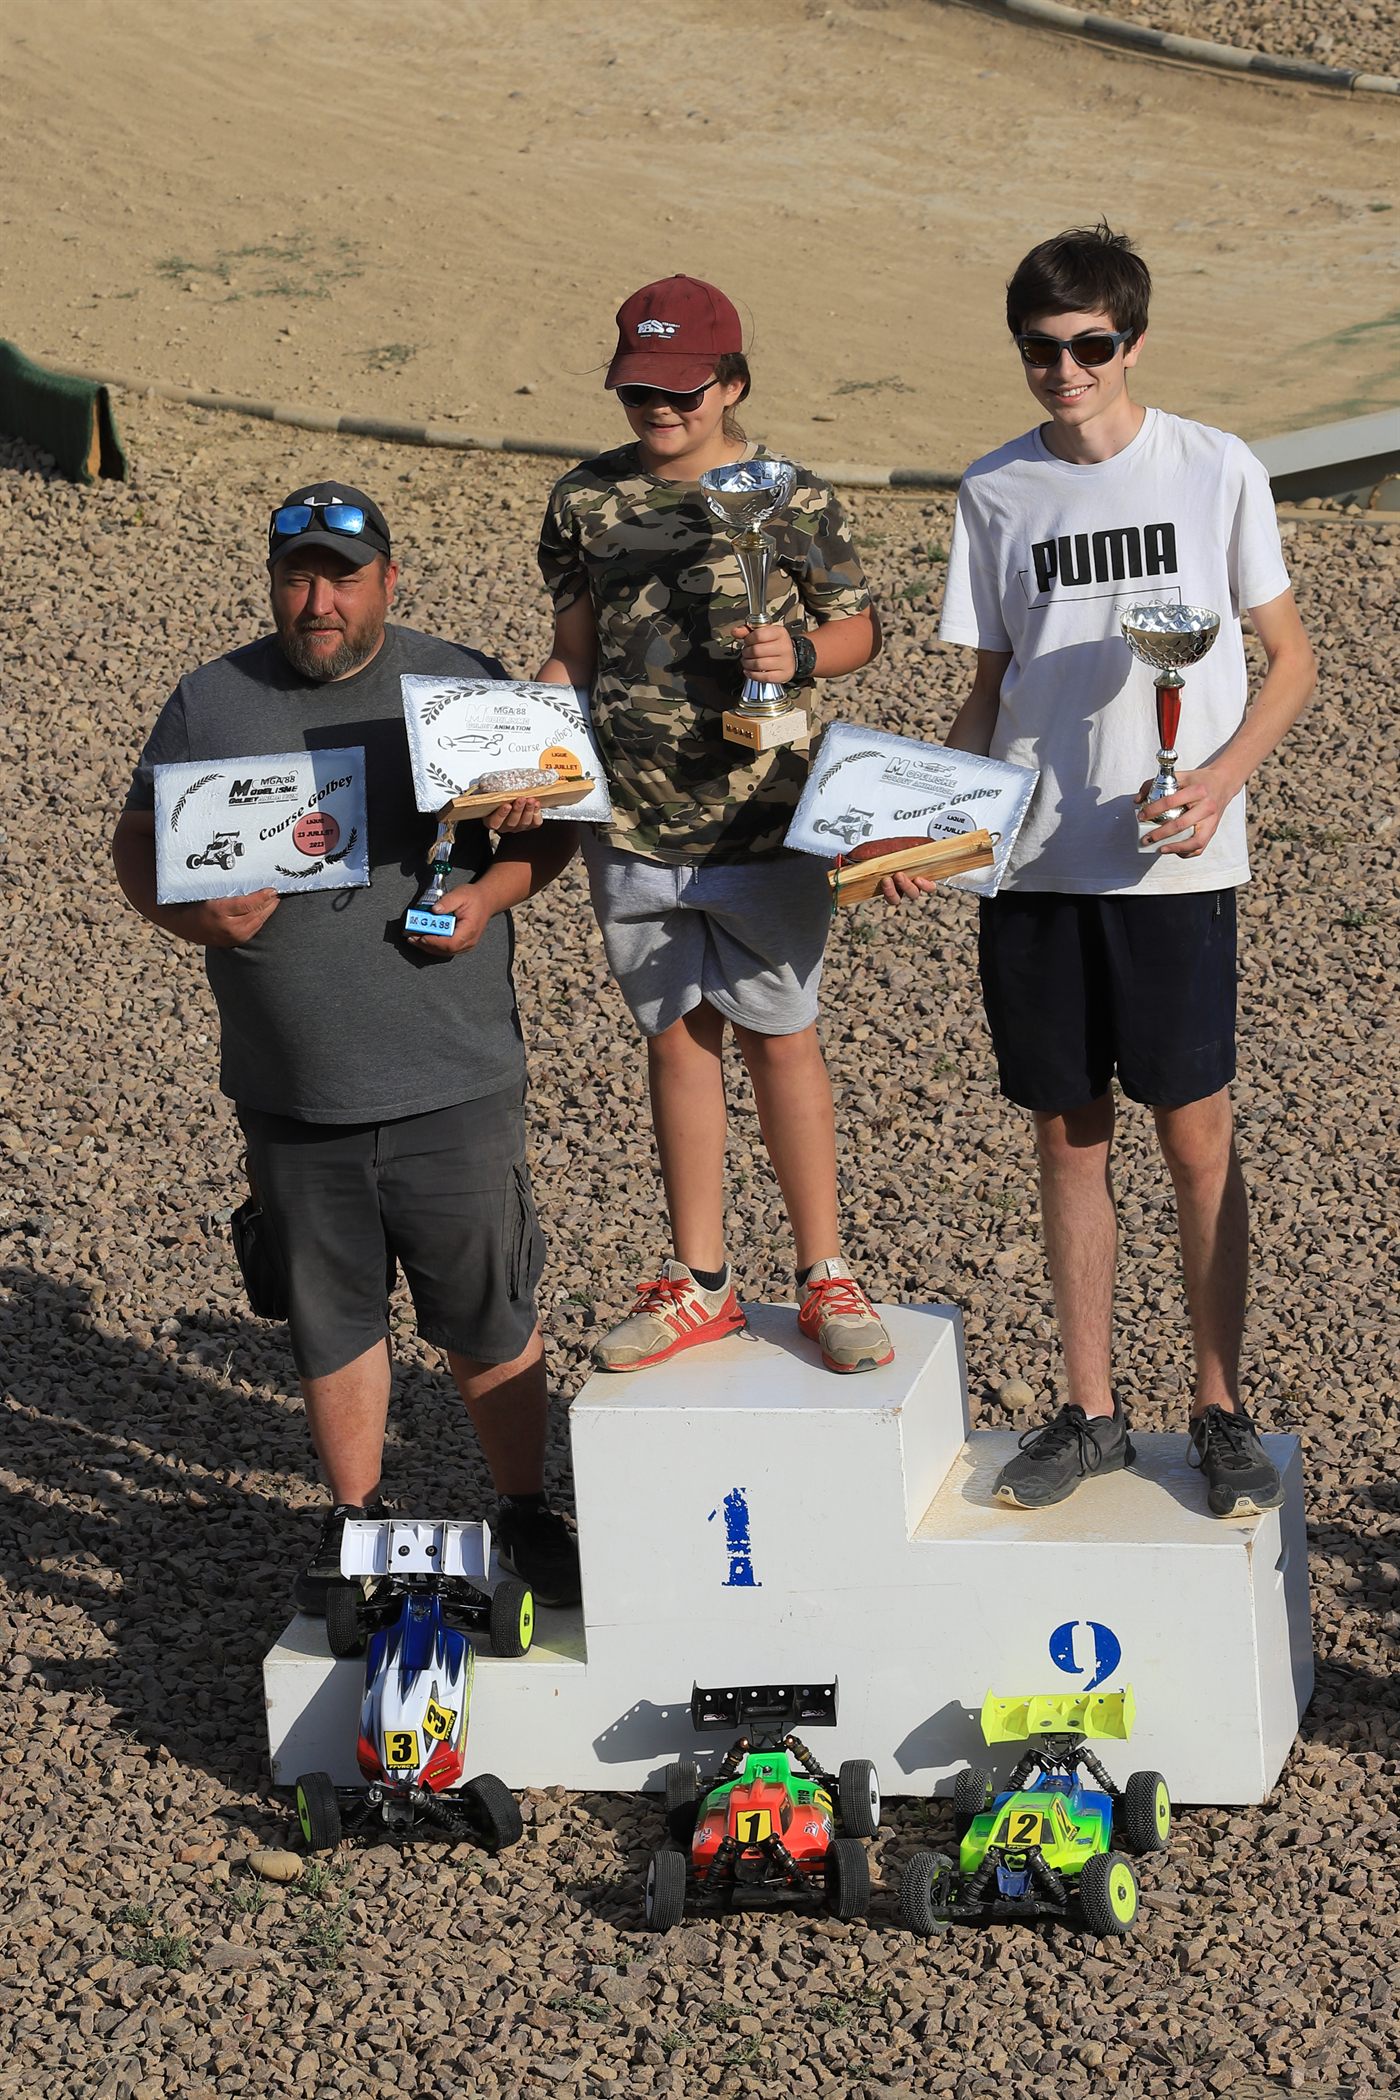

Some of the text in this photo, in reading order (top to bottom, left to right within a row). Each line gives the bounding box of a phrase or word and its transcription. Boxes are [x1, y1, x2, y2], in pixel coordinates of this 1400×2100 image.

[1031, 522, 1178, 593] PUMA
[494, 723, 531, 731] ANIMATION
[508, 726, 573, 752] Course Golbey
[259, 775, 353, 841] Course Golbey
[893, 788, 1003, 820] Course Golbey
[306, 829, 334, 837] JUILLET
[708, 1487, 762, 1587] 1
[427, 1704, 447, 1735] 3
[392, 1733, 412, 1762] 3
[745, 1812, 761, 1843] 1
[1012, 1814, 1038, 1843] 2
